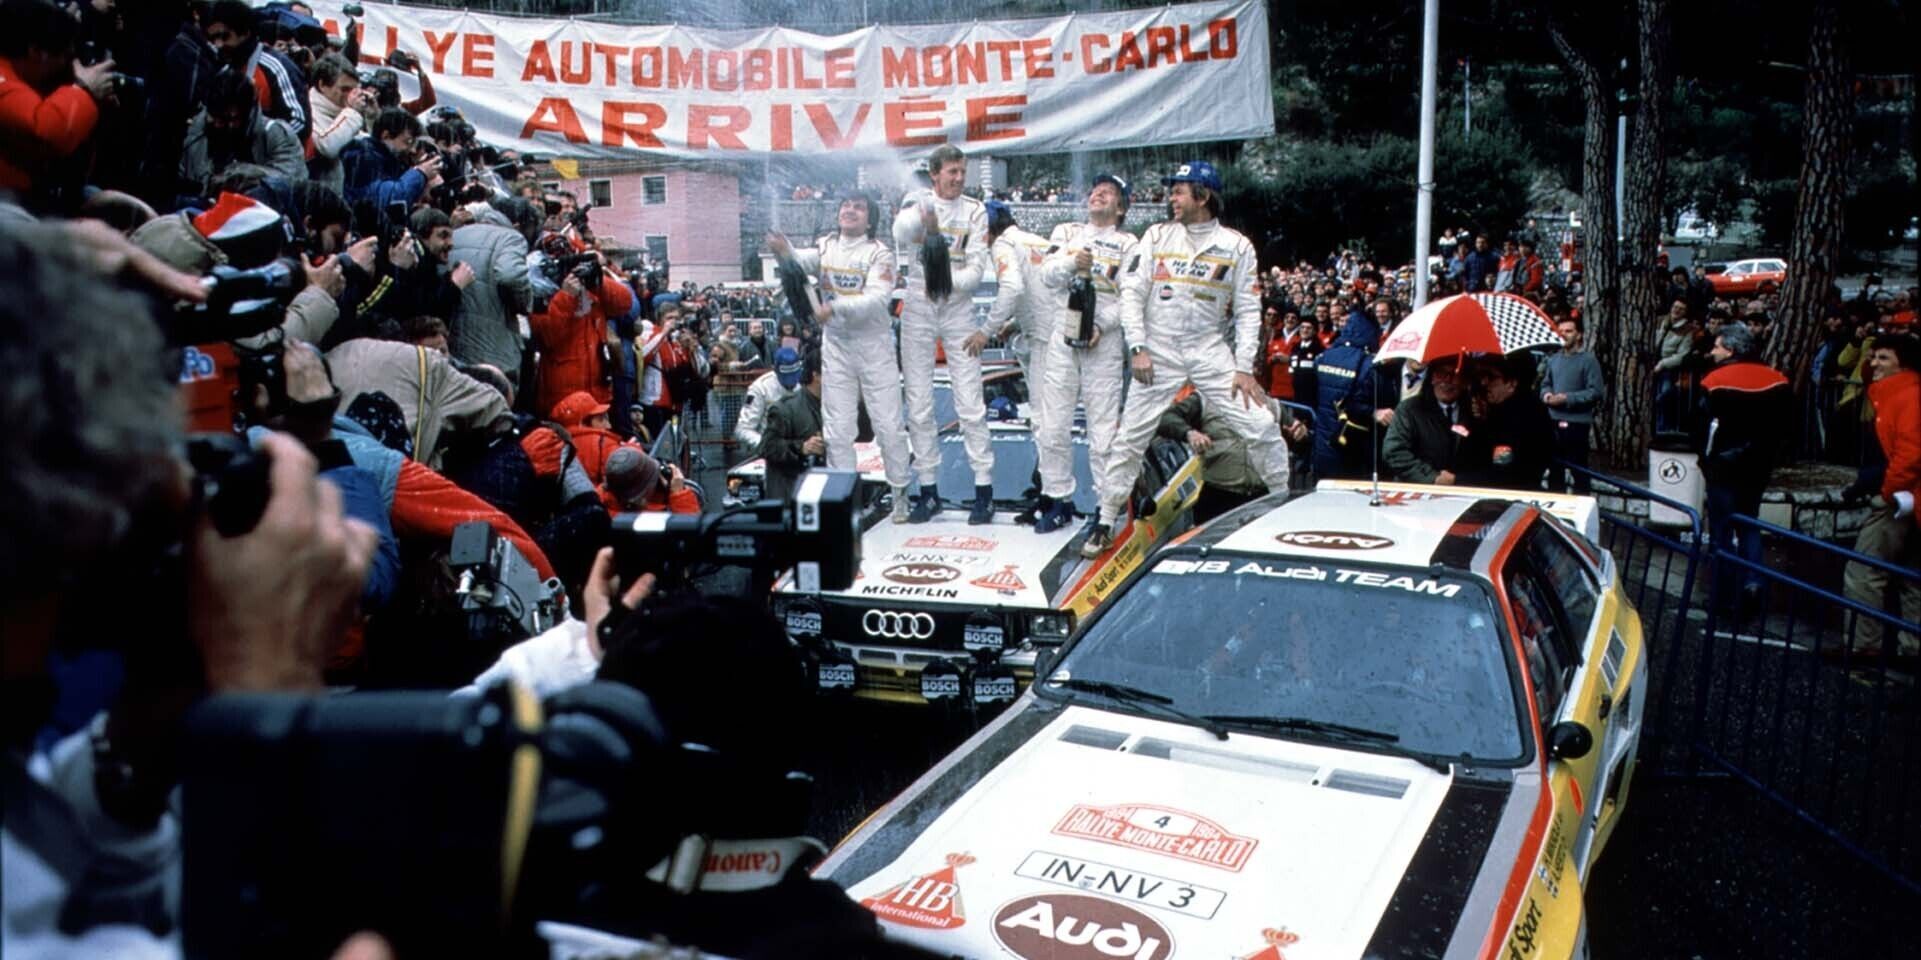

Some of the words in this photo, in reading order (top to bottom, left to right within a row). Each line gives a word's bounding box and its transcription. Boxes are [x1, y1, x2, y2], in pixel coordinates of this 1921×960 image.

[520, 39, 856, 91] AUTOMOBILE
[519, 95, 1028, 150] ARRIVÉE
[1317, 364, 1357, 379] MICHELIN
[1335, 568, 1461, 598] TEAM
[862, 585, 958, 598] MICHELIN
[786, 617, 822, 631] BOSCH
[963, 631, 1003, 645] BOSCH
[819, 670, 855, 682] BOSCH
[921, 680, 960, 693] BOSCH
[974, 682, 1015, 696] BOSCH
[1154, 815, 1171, 828] 4
[1065, 808, 1121, 836] RALLYE
[1121, 826, 1245, 865] MONTE-CARLO
[704, 850, 781, 874] Canon
[1041, 858, 1163, 899] IN-NV
[1168, 887, 1196, 908] 3
[892, 877, 960, 912] HB
